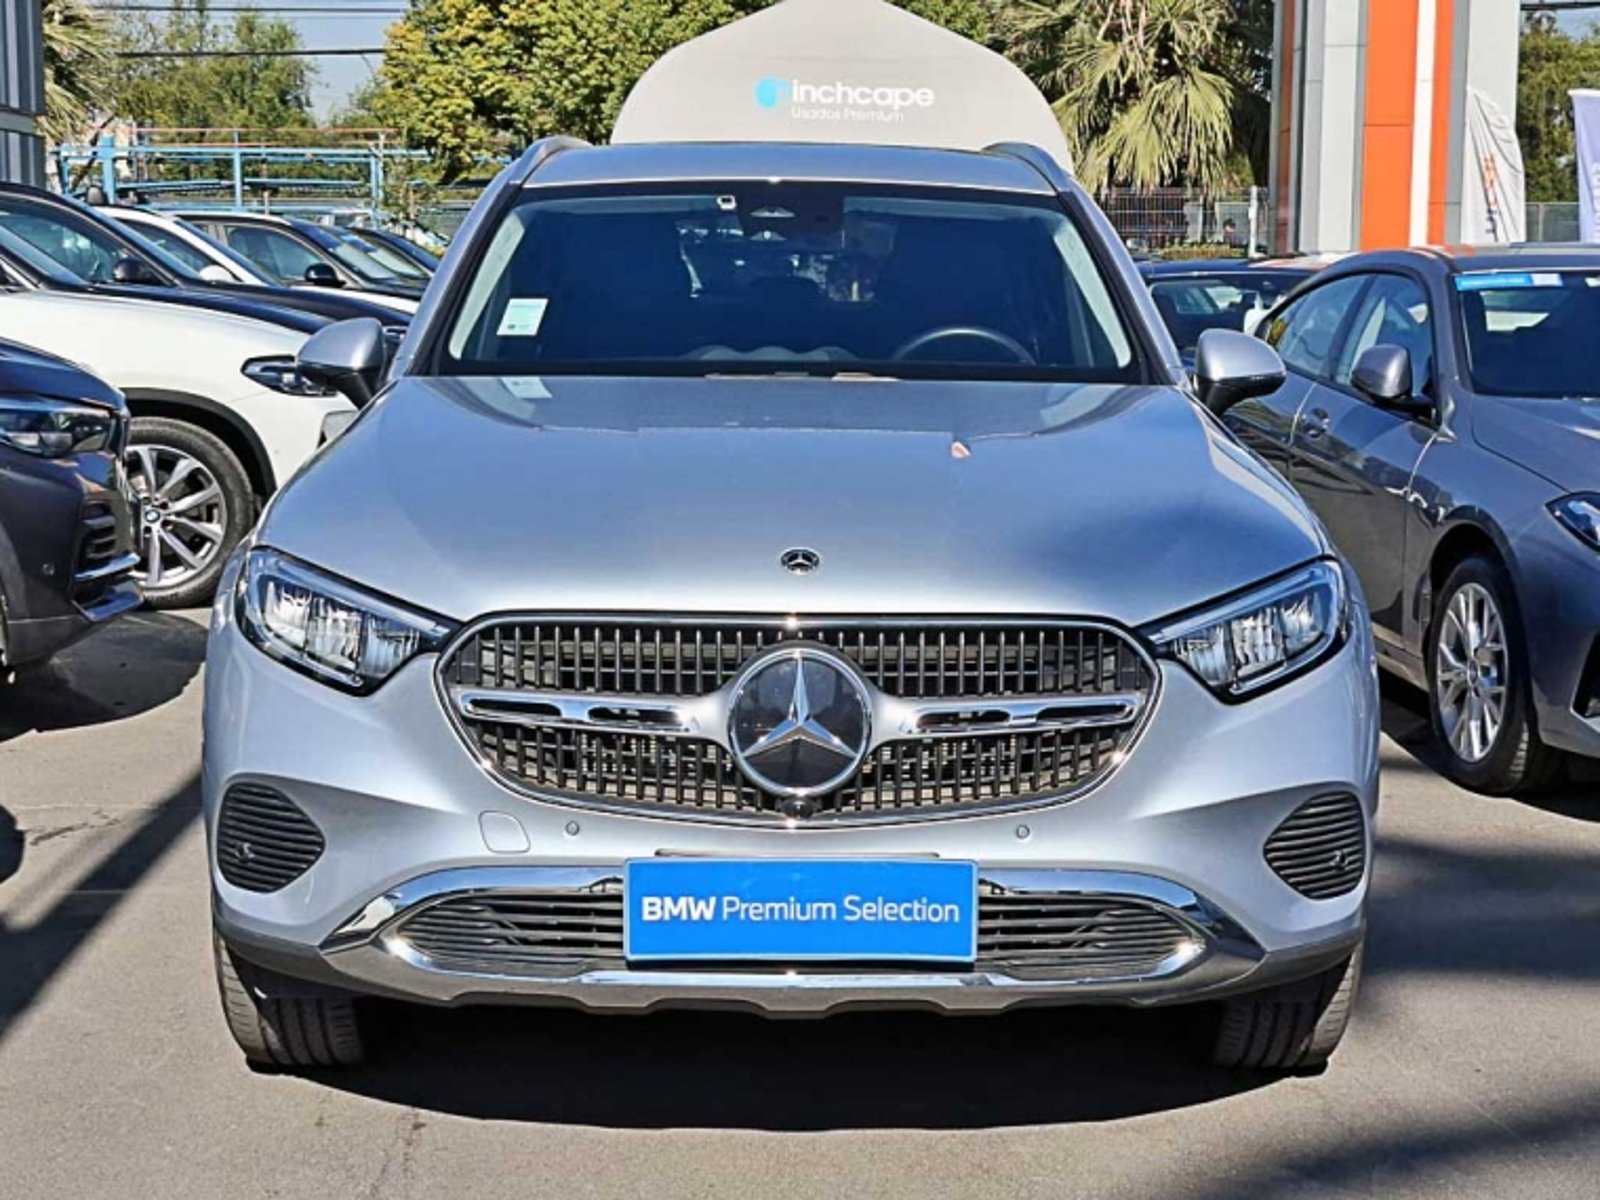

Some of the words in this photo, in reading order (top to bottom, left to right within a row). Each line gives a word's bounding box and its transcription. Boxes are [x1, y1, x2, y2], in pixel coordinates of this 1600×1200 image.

[791, 79, 935, 110] inchcape
[641, 896, 717, 921] BMW
[722, 896, 837, 922] Premium
[843, 895, 960, 923] Selection
